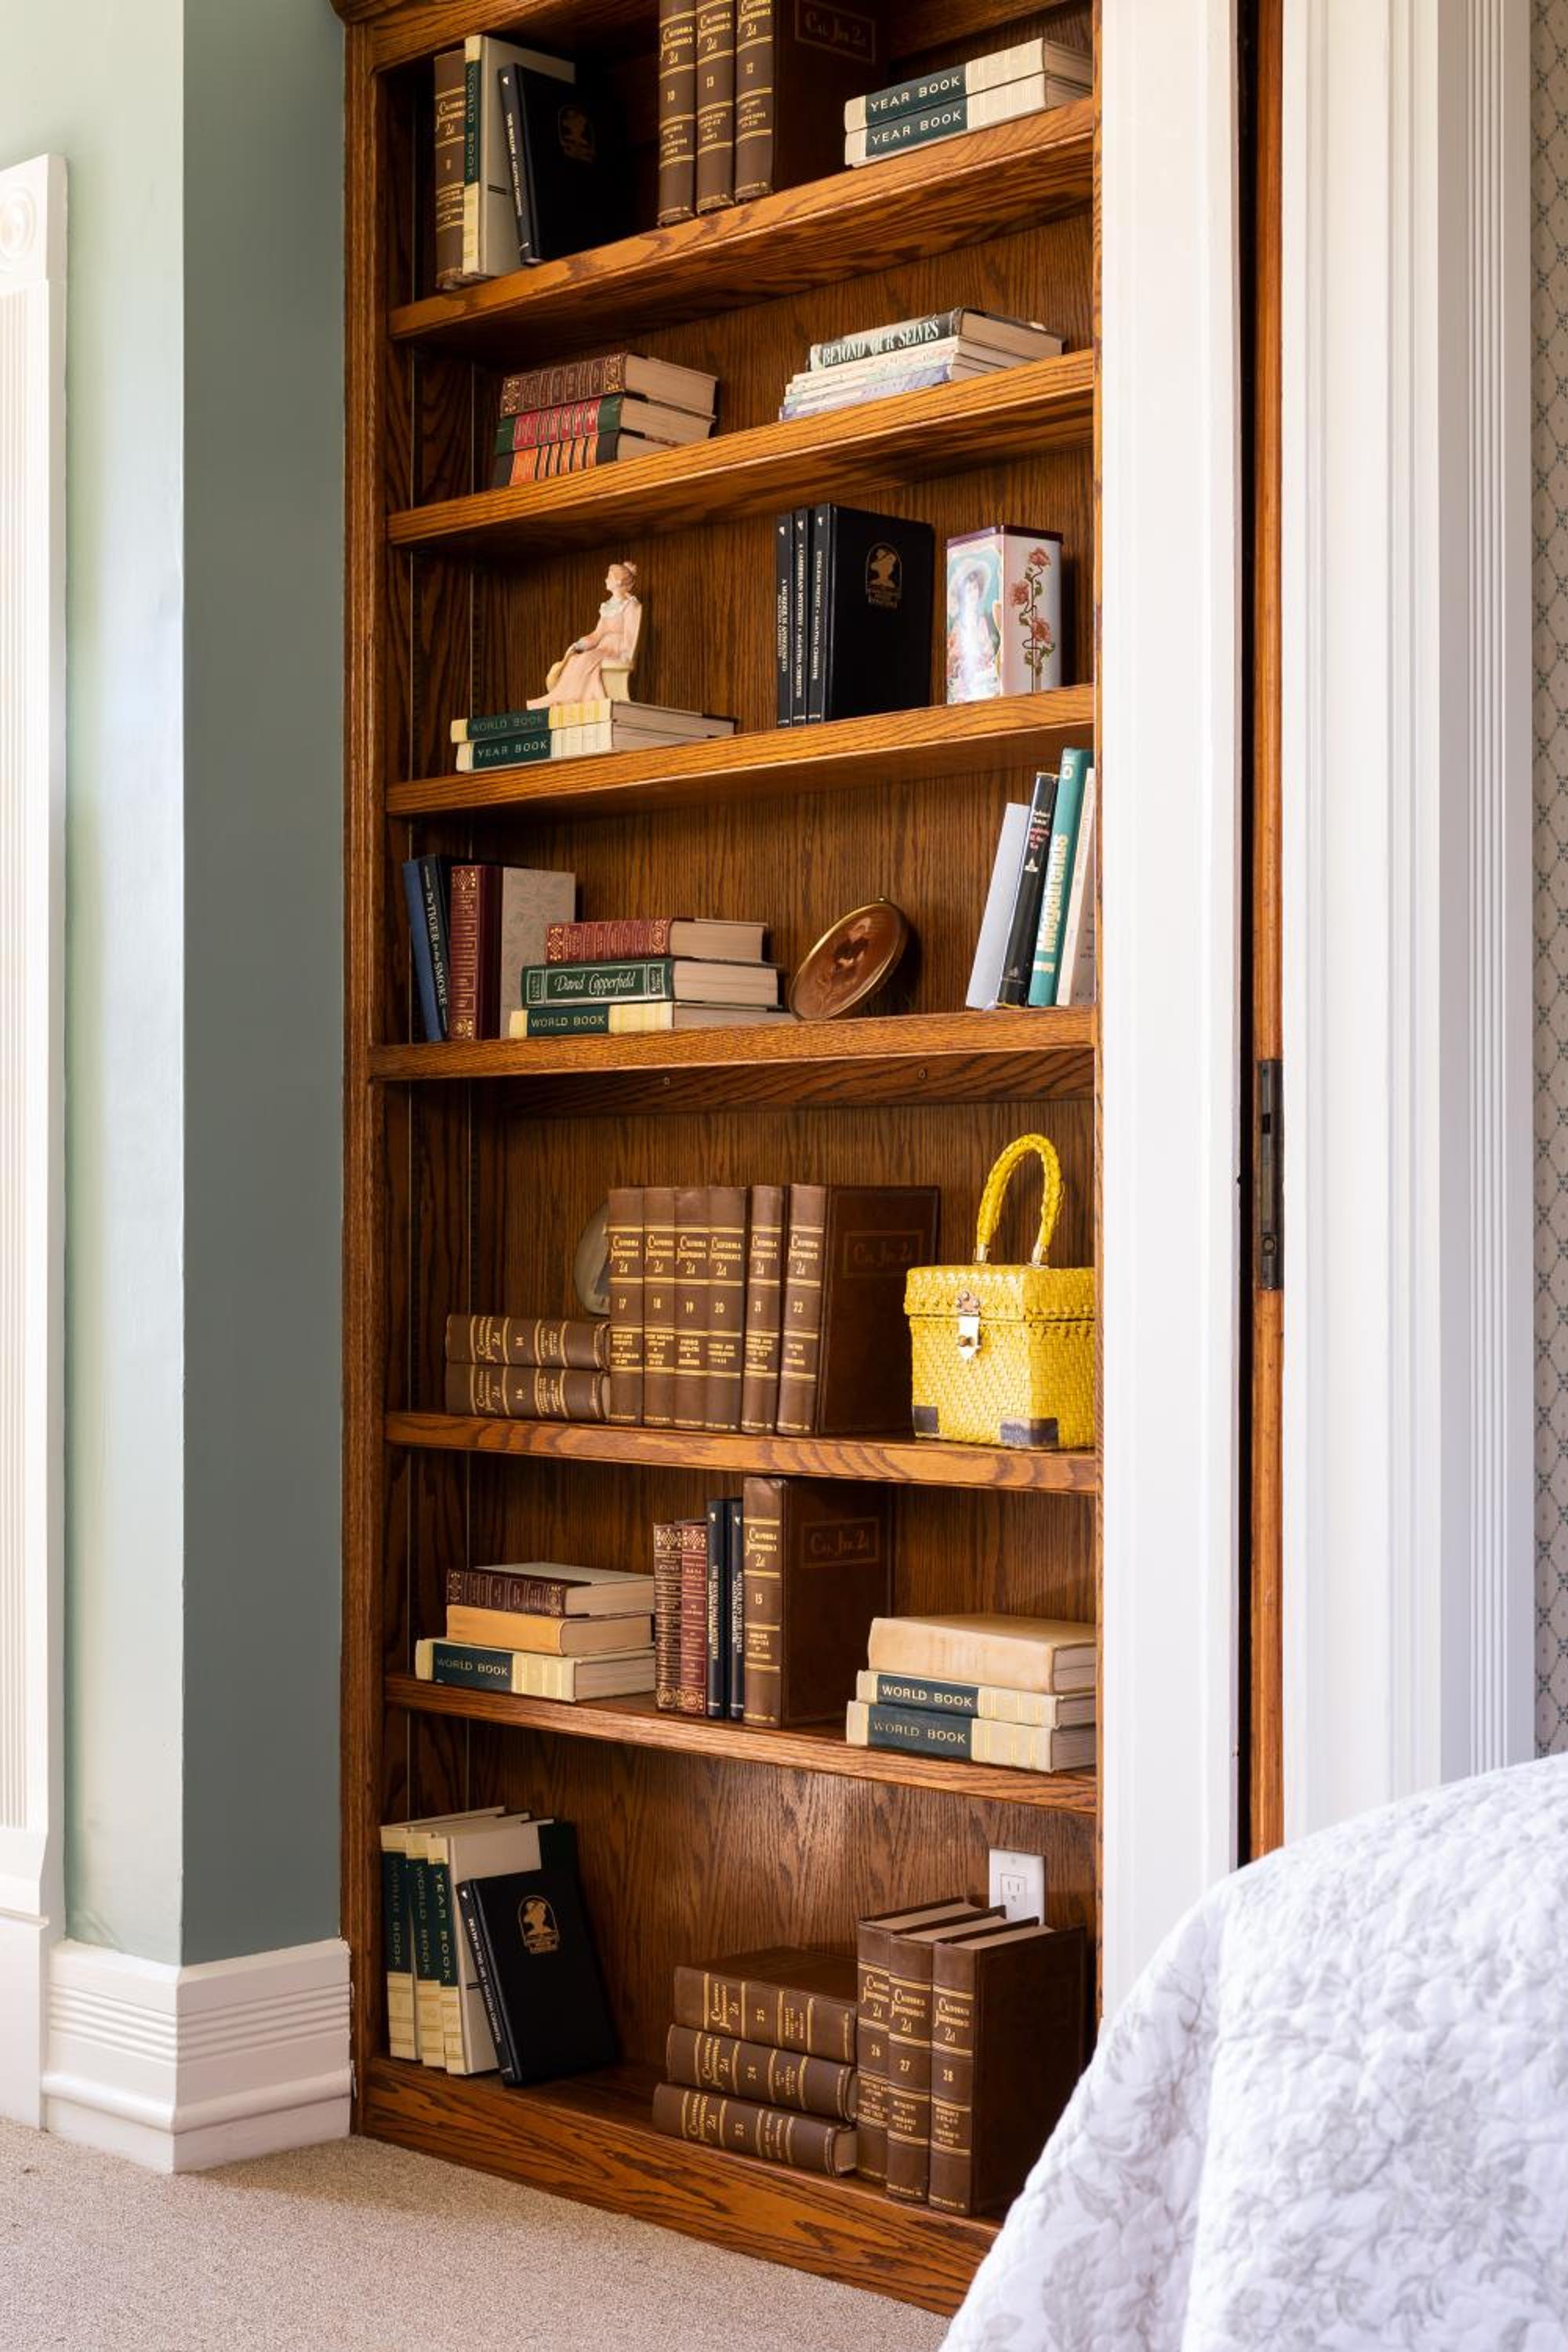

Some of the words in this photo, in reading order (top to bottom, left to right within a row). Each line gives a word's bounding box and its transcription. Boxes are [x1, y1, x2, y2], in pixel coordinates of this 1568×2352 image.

[871, 92, 910, 112] YEAR
[918, 75, 960, 98] BOOK
[872, 125, 911, 144] YEAR
[920, 110, 961, 131] BOOK
[823, 342, 864, 367] BEYOND
[899, 320, 940, 348] SELVES
[477, 746, 508, 757] YEAR
[514, 740, 547, 753] BOOK
[426, 904, 439, 942] TIGER
[434, 963, 448, 1004] SMOKE
[554, 974, 586, 992] David
[589, 971, 635, 995] Copperfield
[531, 1016, 568, 1028] WORLD
[573, 1015, 604, 1026] BOOK
[714, 1302, 724, 1314] 20
[755, 1592, 763, 1605] 15
[437, 1657, 473, 1671] WORLD
[477, 1661, 508, 1676] BOOK
[881, 1684, 927, 1701] WORLD
[934, 1693, 972, 1707] BOOK
[873, 1721, 920, 1737] WORLD
[927, 1730, 966, 1744] BOOK
[434, 1871, 446, 1918] YEAR
[440, 1931, 451, 1980] BOOK
[900, 2060, 910, 2072] 27
